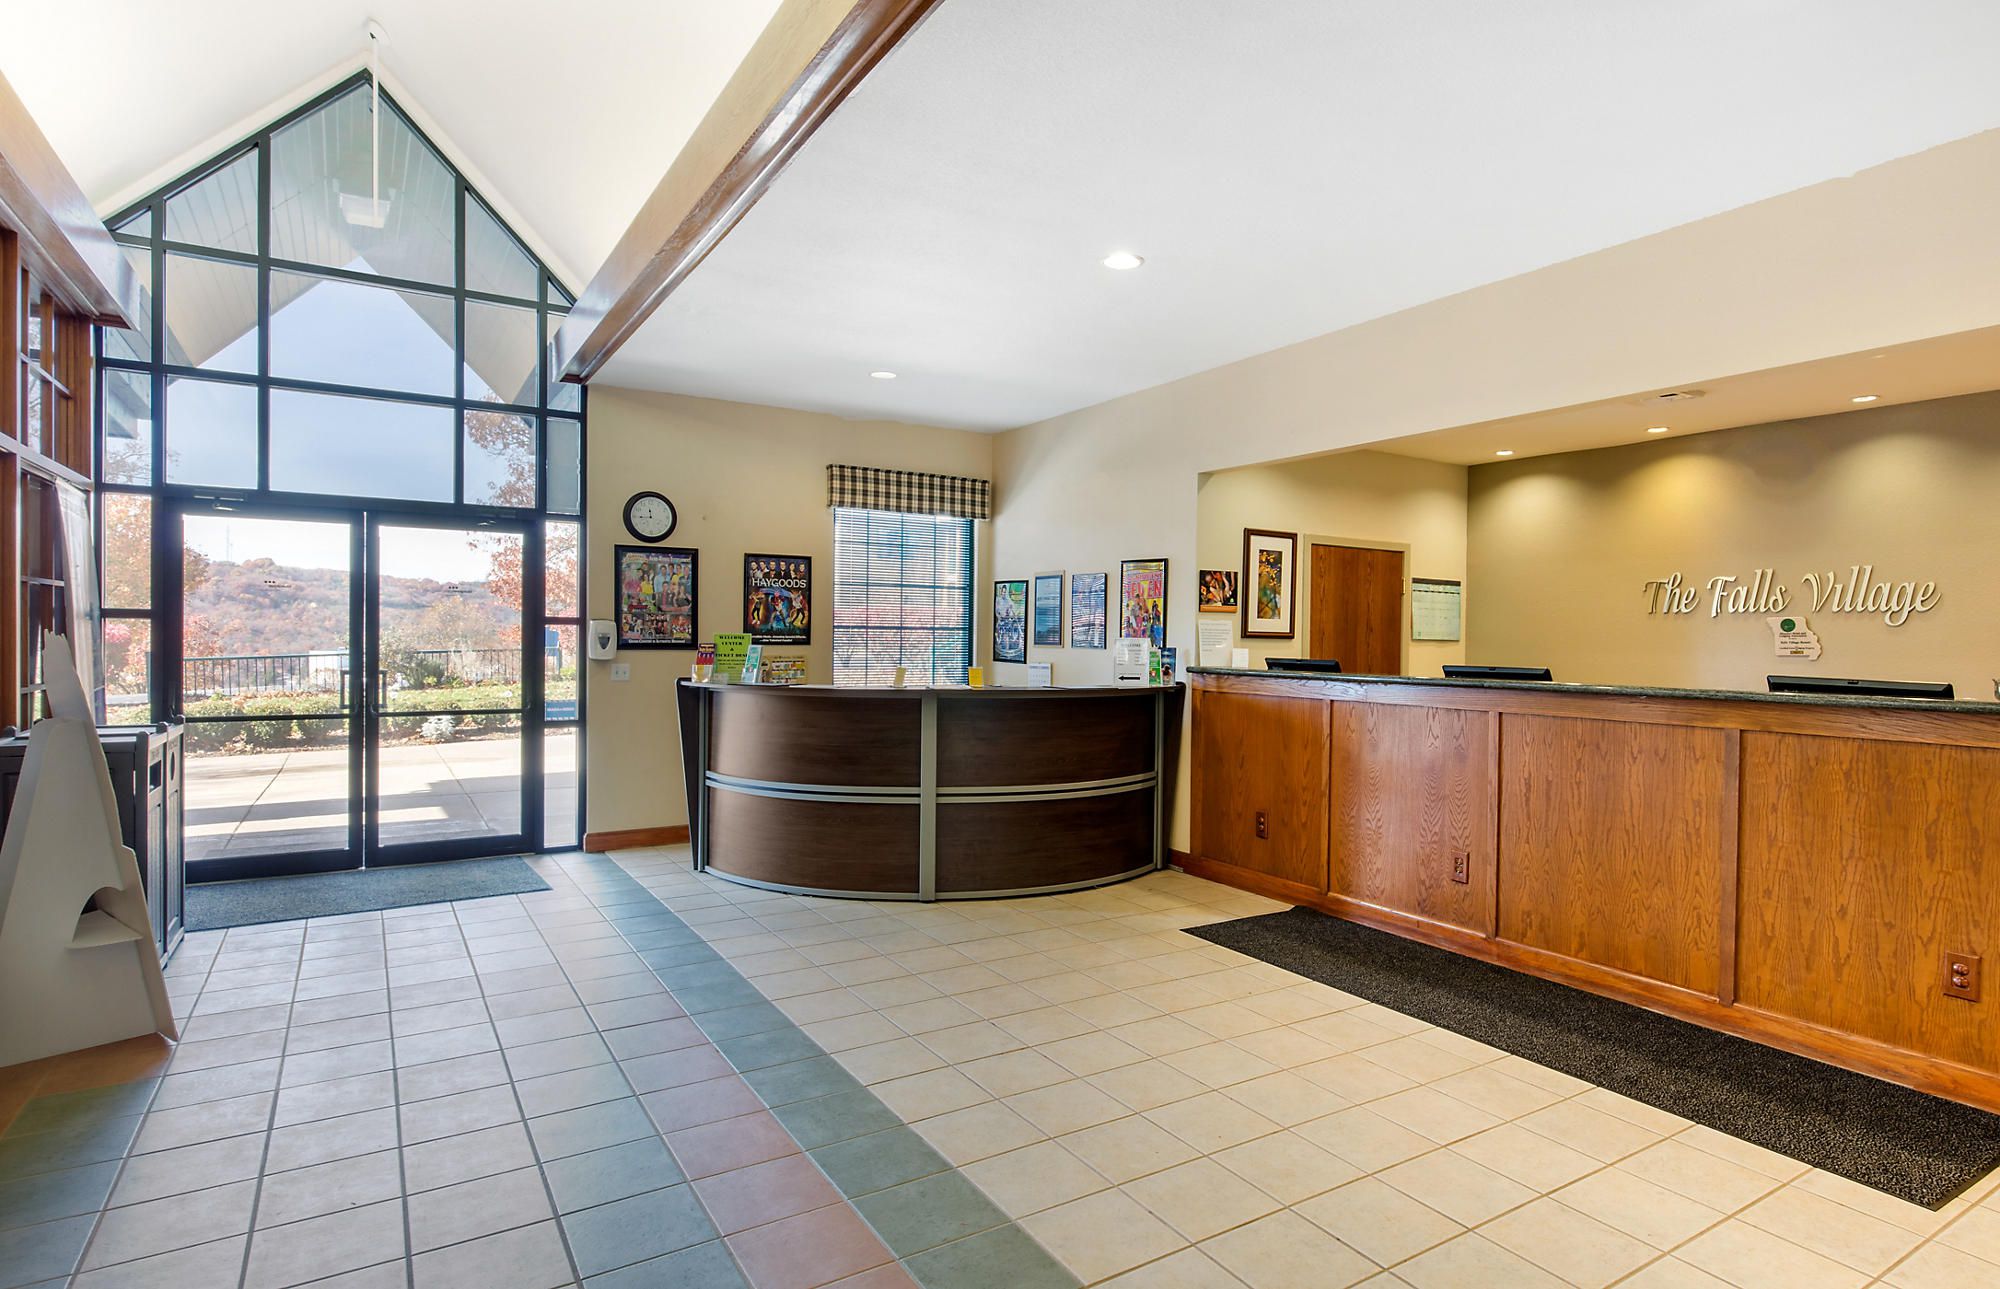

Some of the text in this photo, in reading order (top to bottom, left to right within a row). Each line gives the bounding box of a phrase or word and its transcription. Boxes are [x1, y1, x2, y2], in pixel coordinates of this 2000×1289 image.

[752, 577, 807, 589] HAYGOODS
[1642, 565, 1943, 627] The Falls Village
